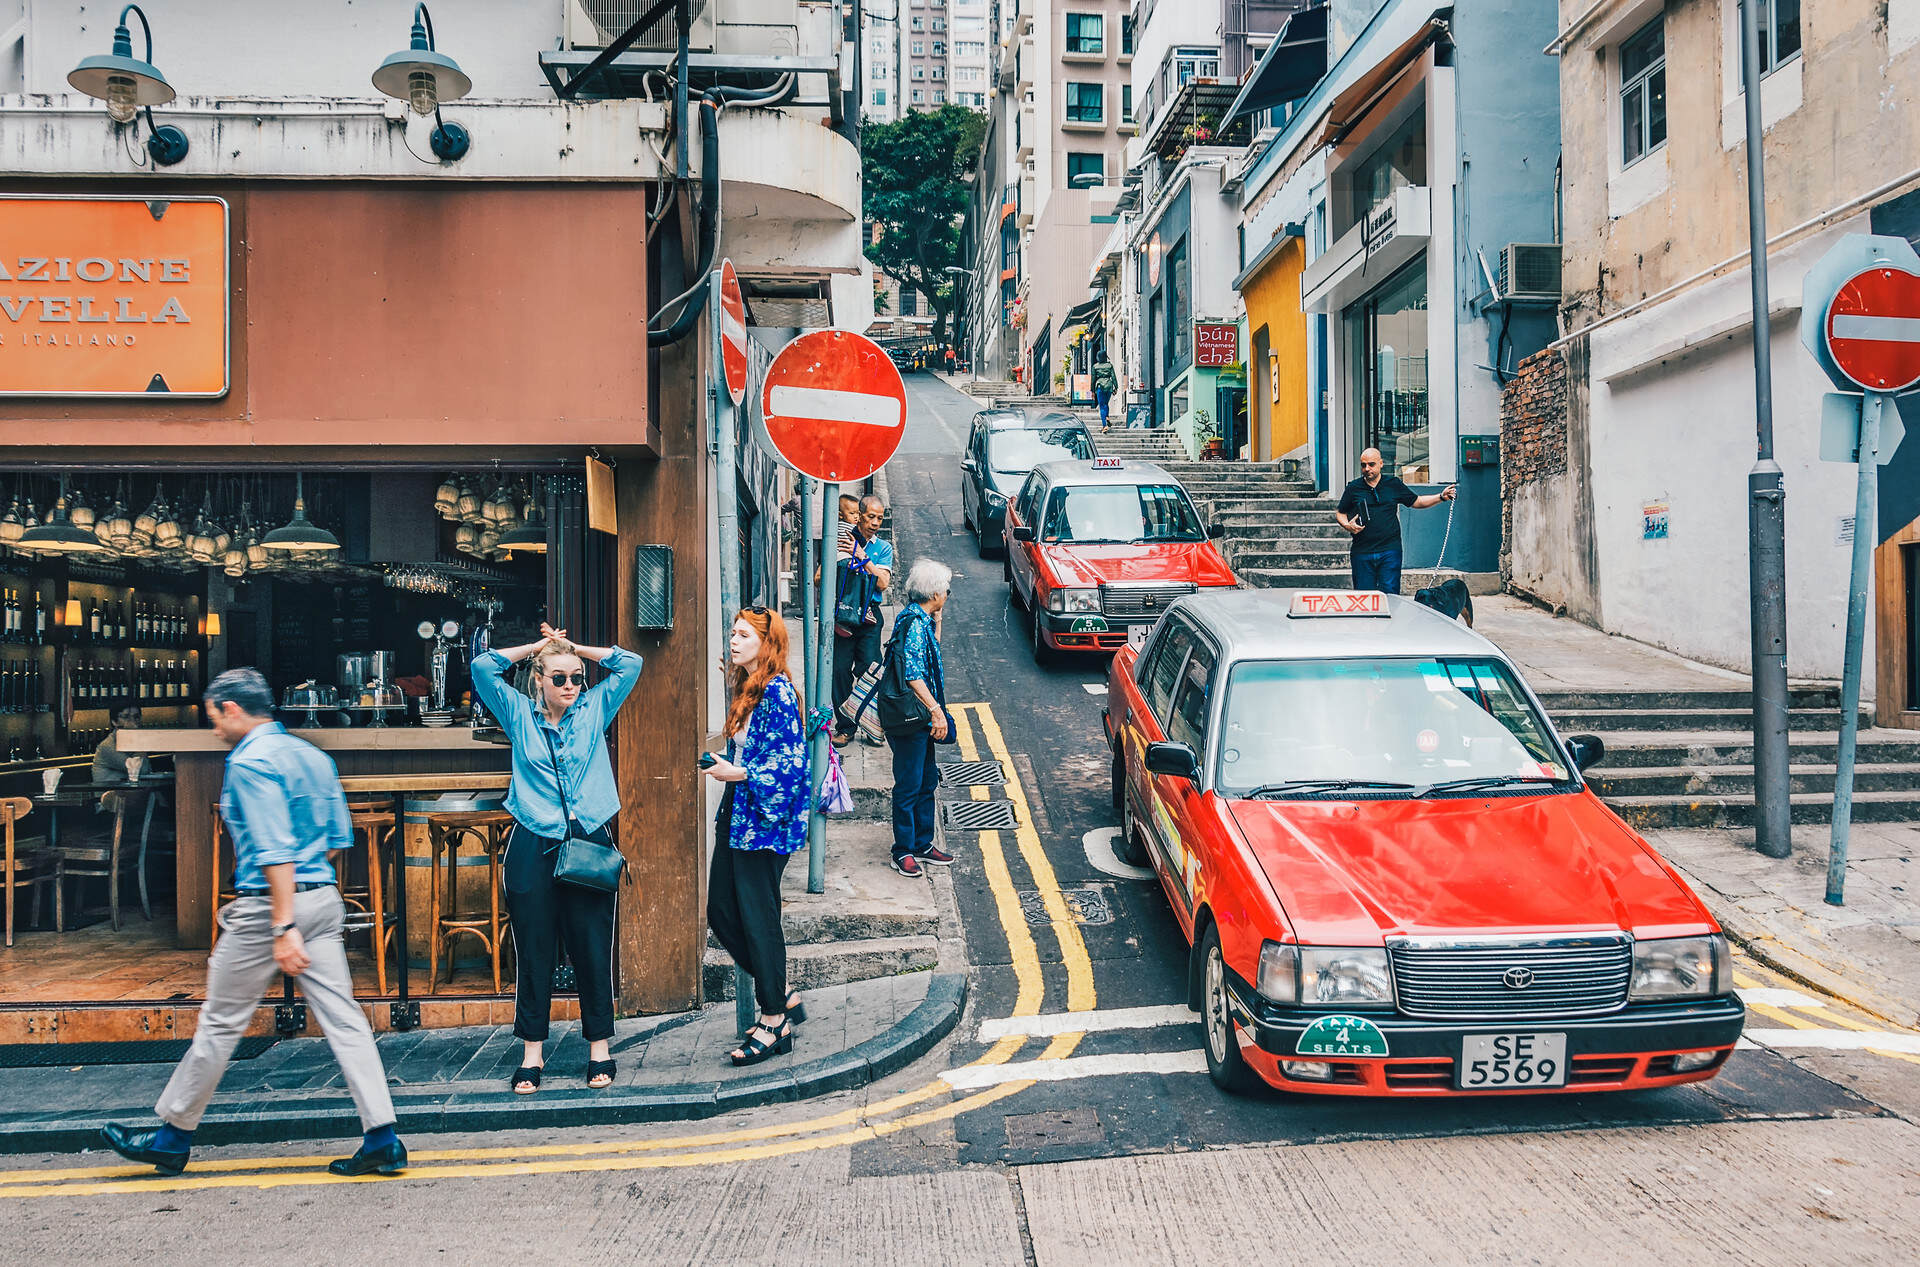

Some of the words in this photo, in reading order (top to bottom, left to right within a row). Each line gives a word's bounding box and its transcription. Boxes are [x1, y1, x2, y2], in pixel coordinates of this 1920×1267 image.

[23, 333, 137, 346] ITALIANO
[1199, 327, 1235, 342] bún
[1097, 459, 1120, 467] TAXI
[1302, 595, 1380, 613] TAXI
[1085, 620, 1093, 628] 5
[1315, 1018, 1366, 1032] TAXI
[1336, 1027, 1350, 1044] 4
[1313, 1044, 1372, 1054] SEATS
[1493, 1035, 1535, 1060] SE
[1468, 1059, 1556, 1085] 5569
